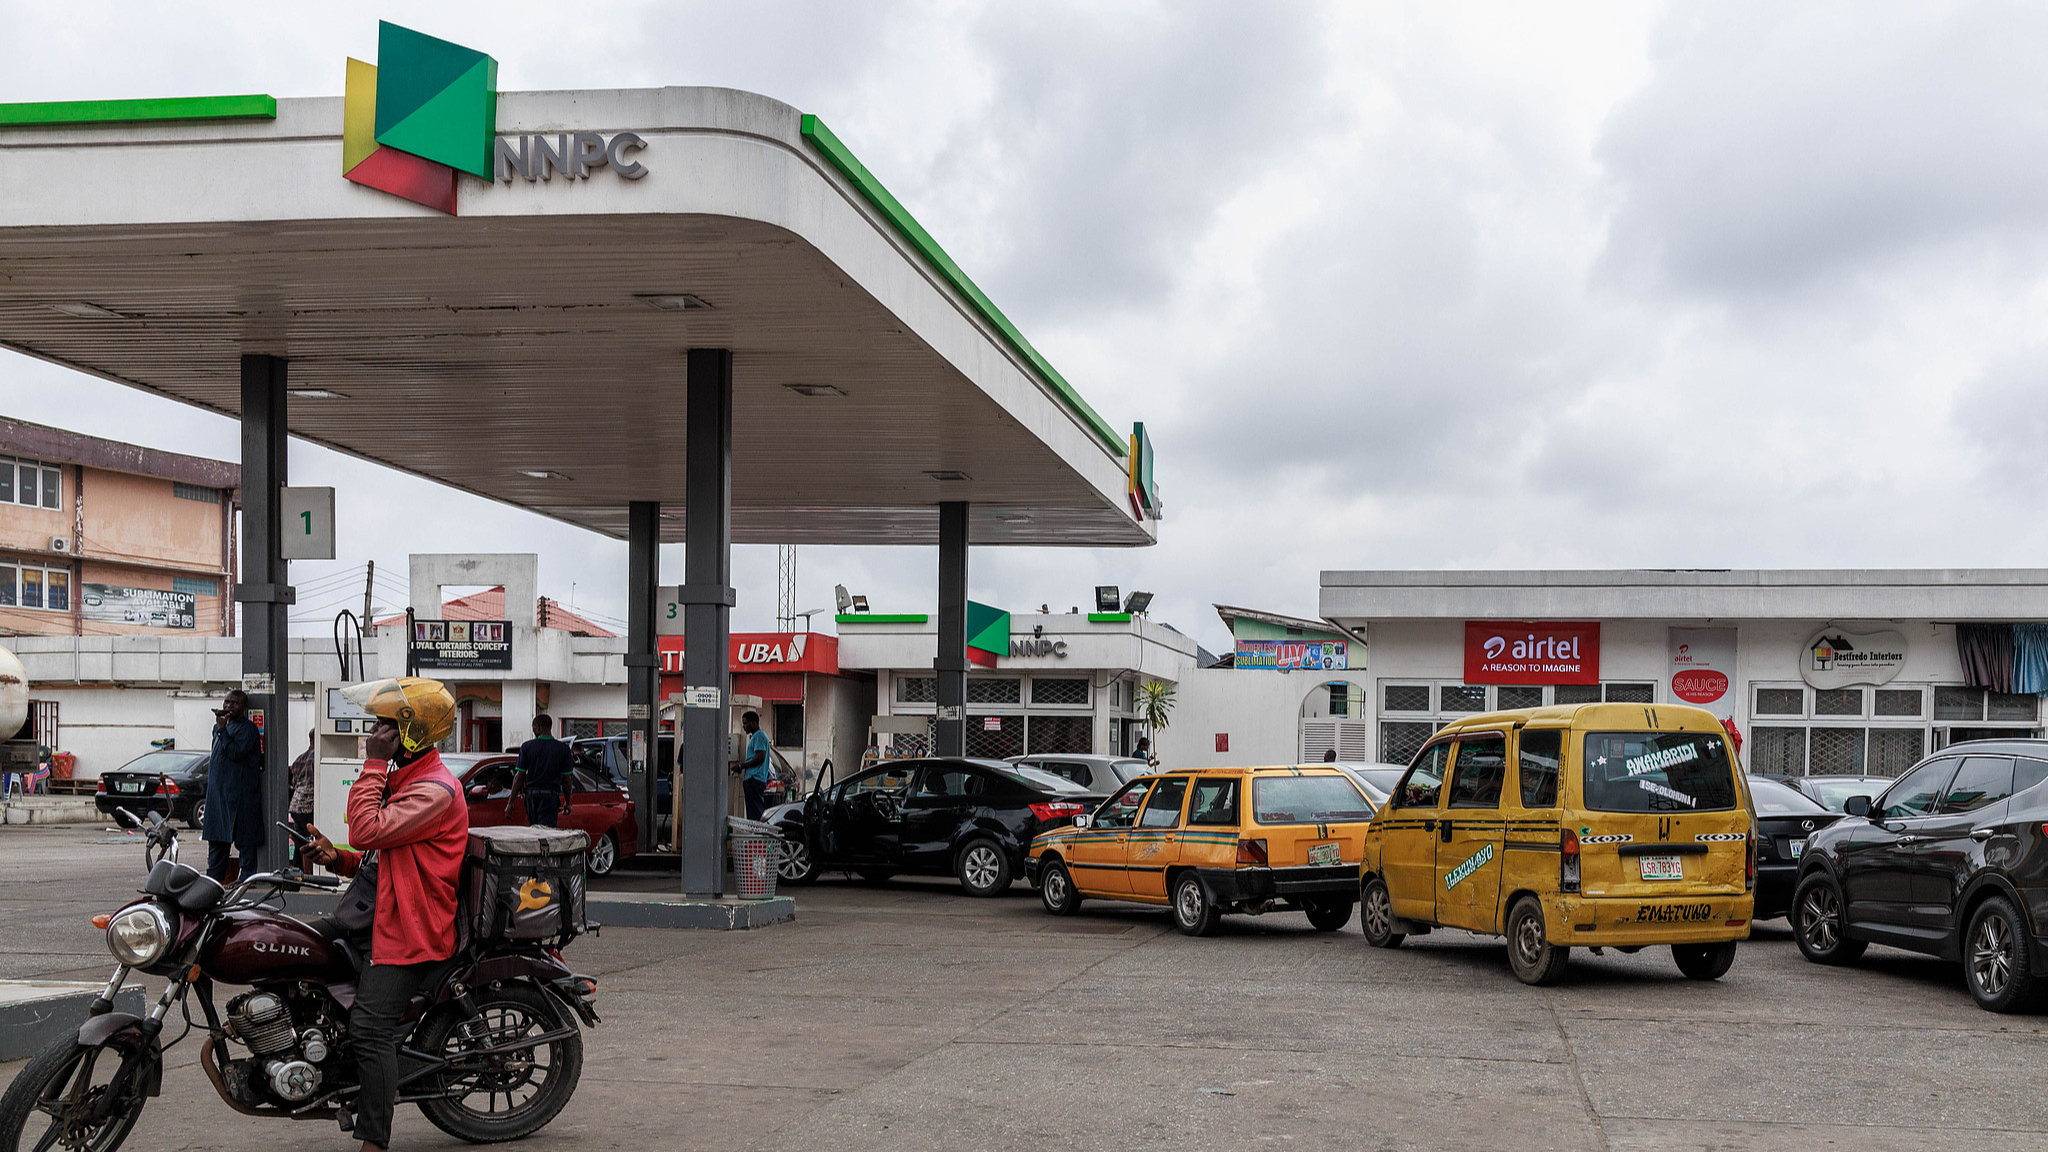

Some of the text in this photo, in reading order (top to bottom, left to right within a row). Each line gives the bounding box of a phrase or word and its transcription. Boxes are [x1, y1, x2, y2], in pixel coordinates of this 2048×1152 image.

[495, 132, 649, 182] NNPC
[300, 510, 311, 535] 1
[123, 588, 194, 603] SUBLIMATION
[133, 599, 186, 610] AVAILABLE
[666, 602, 677, 619] 3
[435, 642, 472, 650] CURTAINS
[473, 642, 509, 651] CONCEPT
[439, 650, 480, 658] INTERIORS
[737, 643, 784, 664] UBA
[1010, 639, 1068, 658] NNPC
[1237, 643, 1276, 653] BORDERLESS
[1511, 633, 1581, 660] airtel
[1236, 655, 1276, 666] SUBLIMATION
[1276, 644, 1305, 668] UV
[1834, 651, 1903, 661] Bestfredo Interiors
[1482, 663, 1581, 673] A REASON TO IMAGINE
[1674, 677, 1727, 692] SAUCE
[1625, 742, 1699, 777] AWAMARIDI
[1641, 861, 1681, 874] LSR-783YG
[1637, 903, 1712, 921] EMATUWO
[253, 940, 310, 957] QLINK
